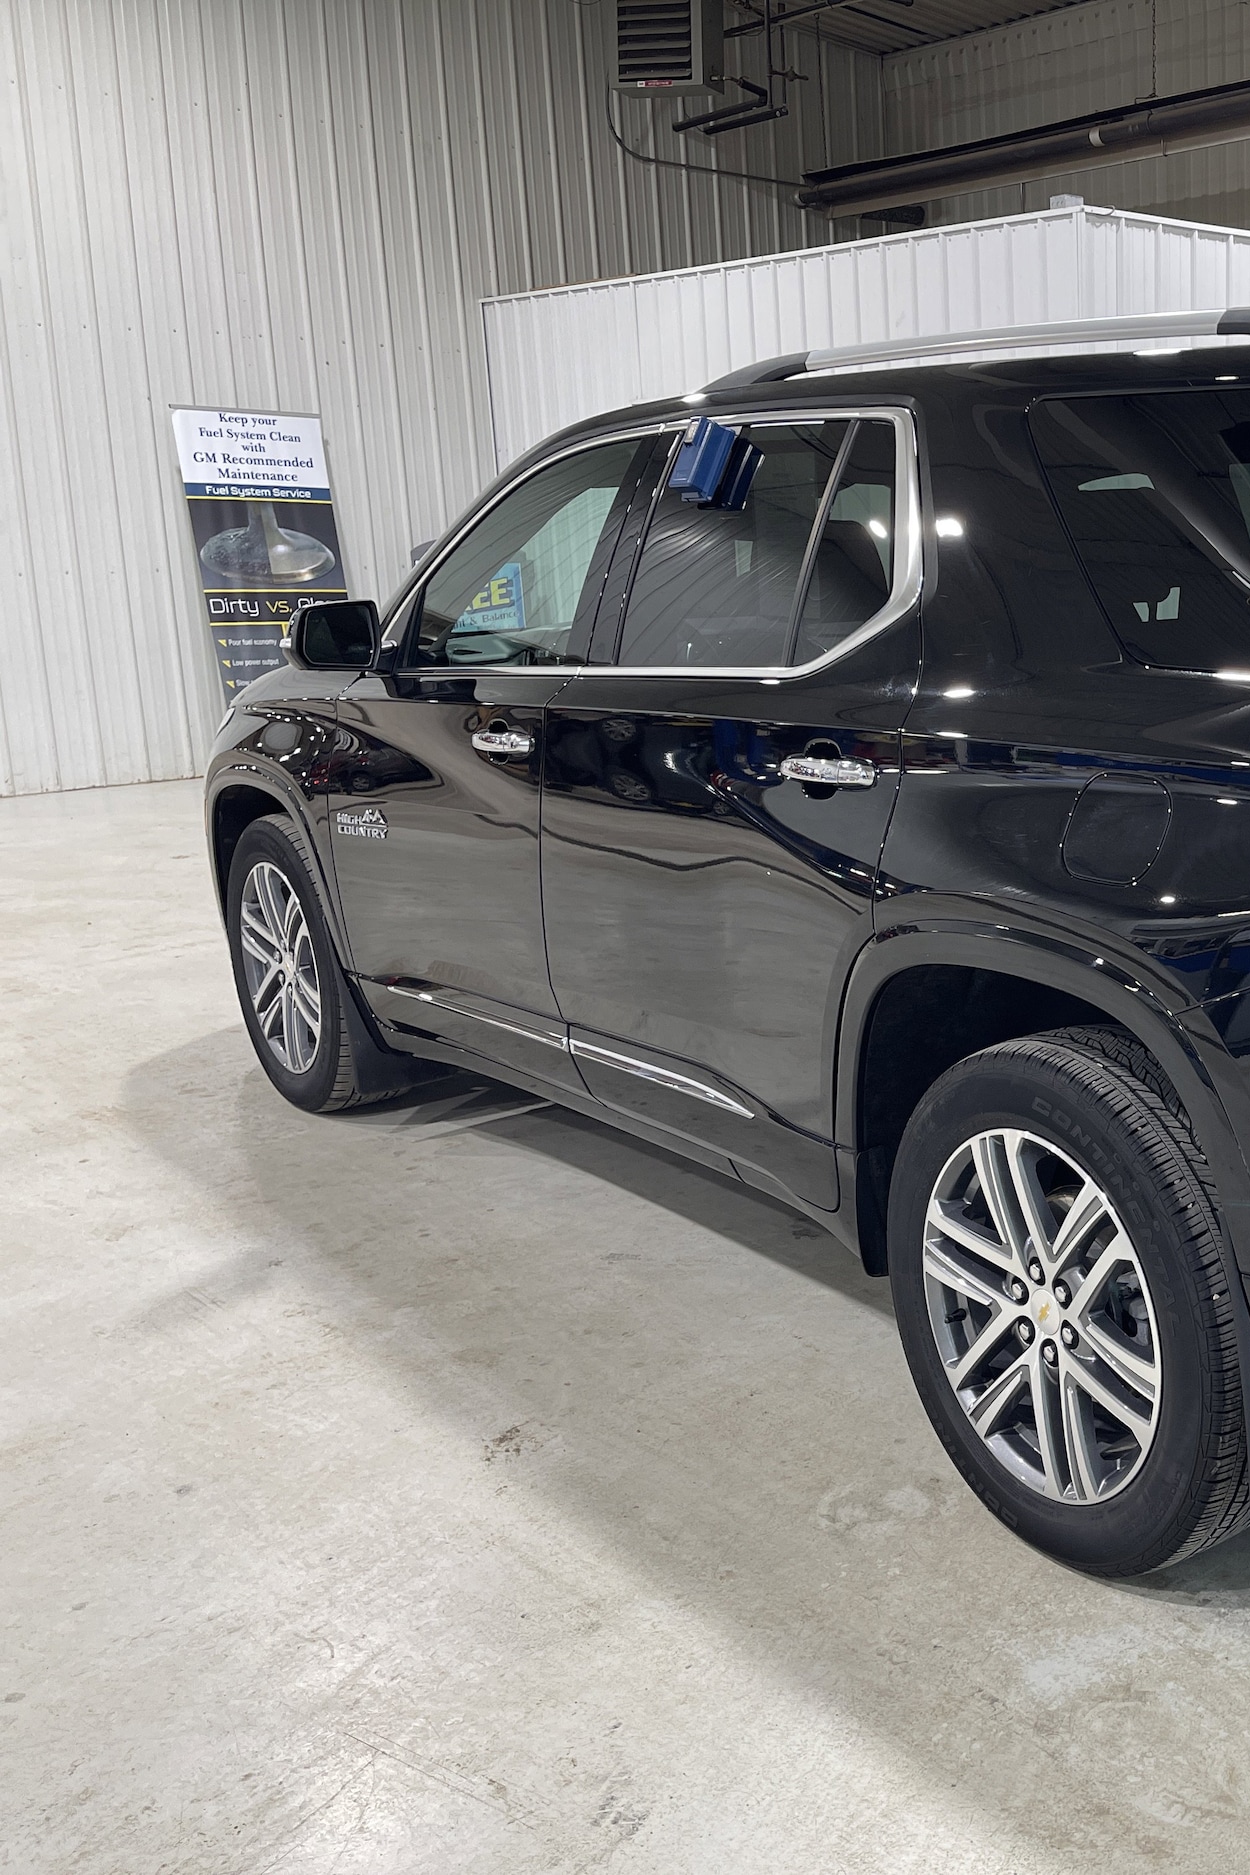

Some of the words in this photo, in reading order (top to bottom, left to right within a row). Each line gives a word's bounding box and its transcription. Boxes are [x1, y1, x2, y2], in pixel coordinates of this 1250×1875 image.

[218, 412, 248, 426] Keep
[251, 416, 278, 428] your
[198, 427, 224, 439] Fuel
[226, 428, 267, 442] System
[269, 430, 302, 443] Clean
[241, 443, 266, 454] with
[193, 452, 217, 464] GM
[222, 454, 314, 468] Recommended
[217, 468, 298, 482] Maintenance
[205, 485, 230, 496] Fuel
[230, 486, 272, 498] System
[272, 488, 312, 499] Service
[209, 598, 260, 617] Dirty
[266, 600, 292, 614] vs.
[337, 812, 362, 824] HIGH
[338, 824, 388, 839] COUNTRY
